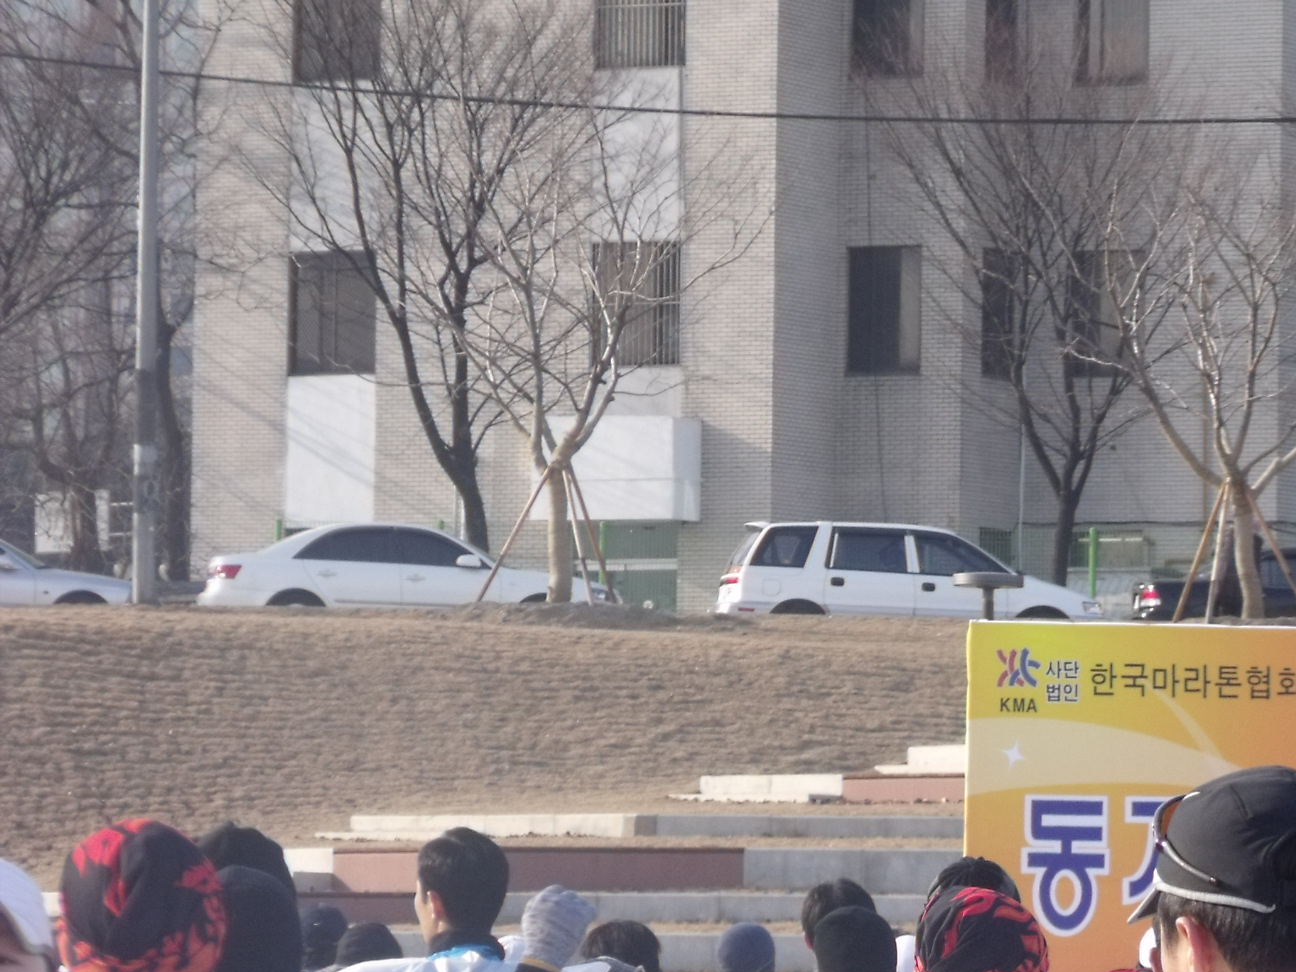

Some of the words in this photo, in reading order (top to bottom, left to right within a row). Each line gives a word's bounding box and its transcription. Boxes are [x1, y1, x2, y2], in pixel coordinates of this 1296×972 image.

[1046, 660, 1080, 679] 사단
[1046, 684, 1080, 702] 법인
[1000, 698, 1038, 713] KMA
